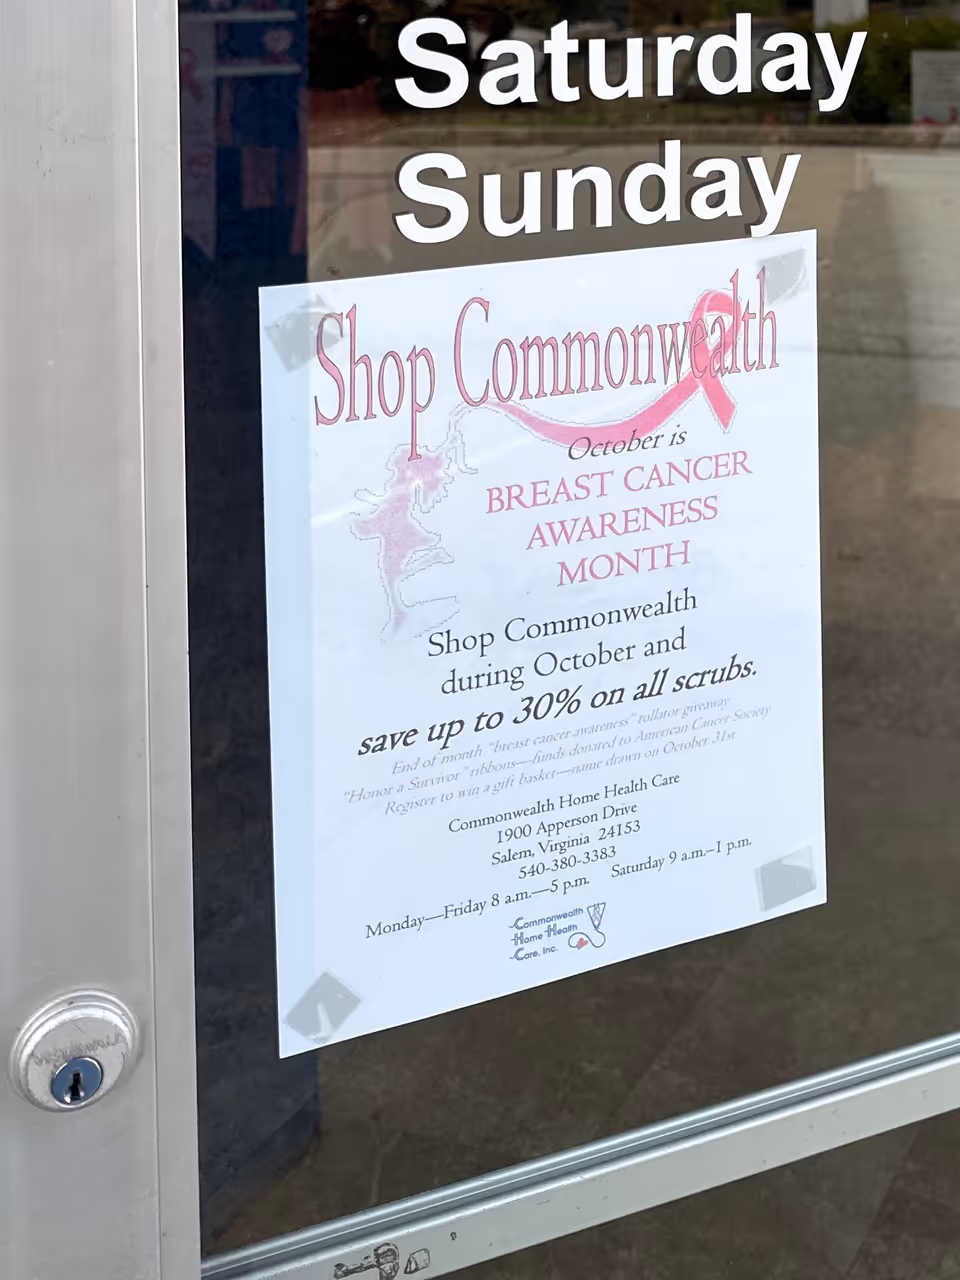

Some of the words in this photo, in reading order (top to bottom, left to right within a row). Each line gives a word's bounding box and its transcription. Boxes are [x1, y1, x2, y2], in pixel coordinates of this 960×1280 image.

[396, 13, 867, 111] Saturday
[396, 140, 801, 242] Sunday
[315, 303, 435, 461] Shop
[454, 266, 780, 408] Commonwealth
[569, 430, 663, 460] October
[669, 426, 687, 446] is
[486, 471, 613, 514] BREAST
[624, 450, 753, 492] CANCER
[526, 495, 719, 550] AWARENESS
[557, 540, 691, 587] MONTH
[428, 618, 495, 657] Shop
[505, 587, 698, 641] Commonwealth
[441, 658, 524, 696] during
[534, 642, 635, 677] October
[644, 626, 687, 657] and
[358, 728, 418, 755] save
[428, 719, 464, 750] up
[474, 711, 503, 732] to
[513, 686, 581, 726] 30%
[591, 687, 624, 708] on
[633, 669, 665, 701] all
[672, 653, 758, 693] scrubs.
[392, 758, 419, 774] End
[423, 752, 440, 768] of
[441, 744, 482, 764] month
[533, 727, 574, 745] cancer
[638, 708, 680, 723] rollator
[682, 697, 730, 718] giveaway
[385, 795, 436, 815] Register
[441, 791, 453, 802] to
[458, 785, 480, 798] win
[483, 783, 490, 792] a
[492, 775, 515, 795] gift
[606, 751, 640, 767] drawn
[644, 749, 659, 758] on
[663, 737, 710, 754] October
[712, 730, 735, 744] 31st
[396, 785, 404, 793] a
[569, 735, 618, 756] donated
[619, 734, 631, 746] to
[634, 724, 688, 742] American
[692, 715, 730, 730] Cancer
[732, 706, 771, 721] Society
[448, 797, 554, 833] Commonwealth
[559, 791, 600, 811] Home
[604, 778, 648, 801] Health
[652, 773, 680, 787] Care
[497, 824, 532, 844] 1900
[536, 813, 599, 837] Apperson
[603, 802, 638, 820] Drive
[491, 847, 535, 866] Salem,
[538, 832, 590, 857] Virginia
[598, 820, 641, 842] 24153
[491, 894, 500, 908] 8
[562, 876, 590, 898] p.m.
[611, 857, 665, 878] Saturday
[668, 851, 677, 864] 9
[726, 838, 752, 857] p.m.
[519, 846, 617, 879] 540-380-3383
[509, 907, 583, 930] Commonwealth
[511, 932, 543, 946] Home
[544, 924, 578, 937] Health
[509, 947, 541, 960] Care,
[543, 946, 558, 955] Inc.
